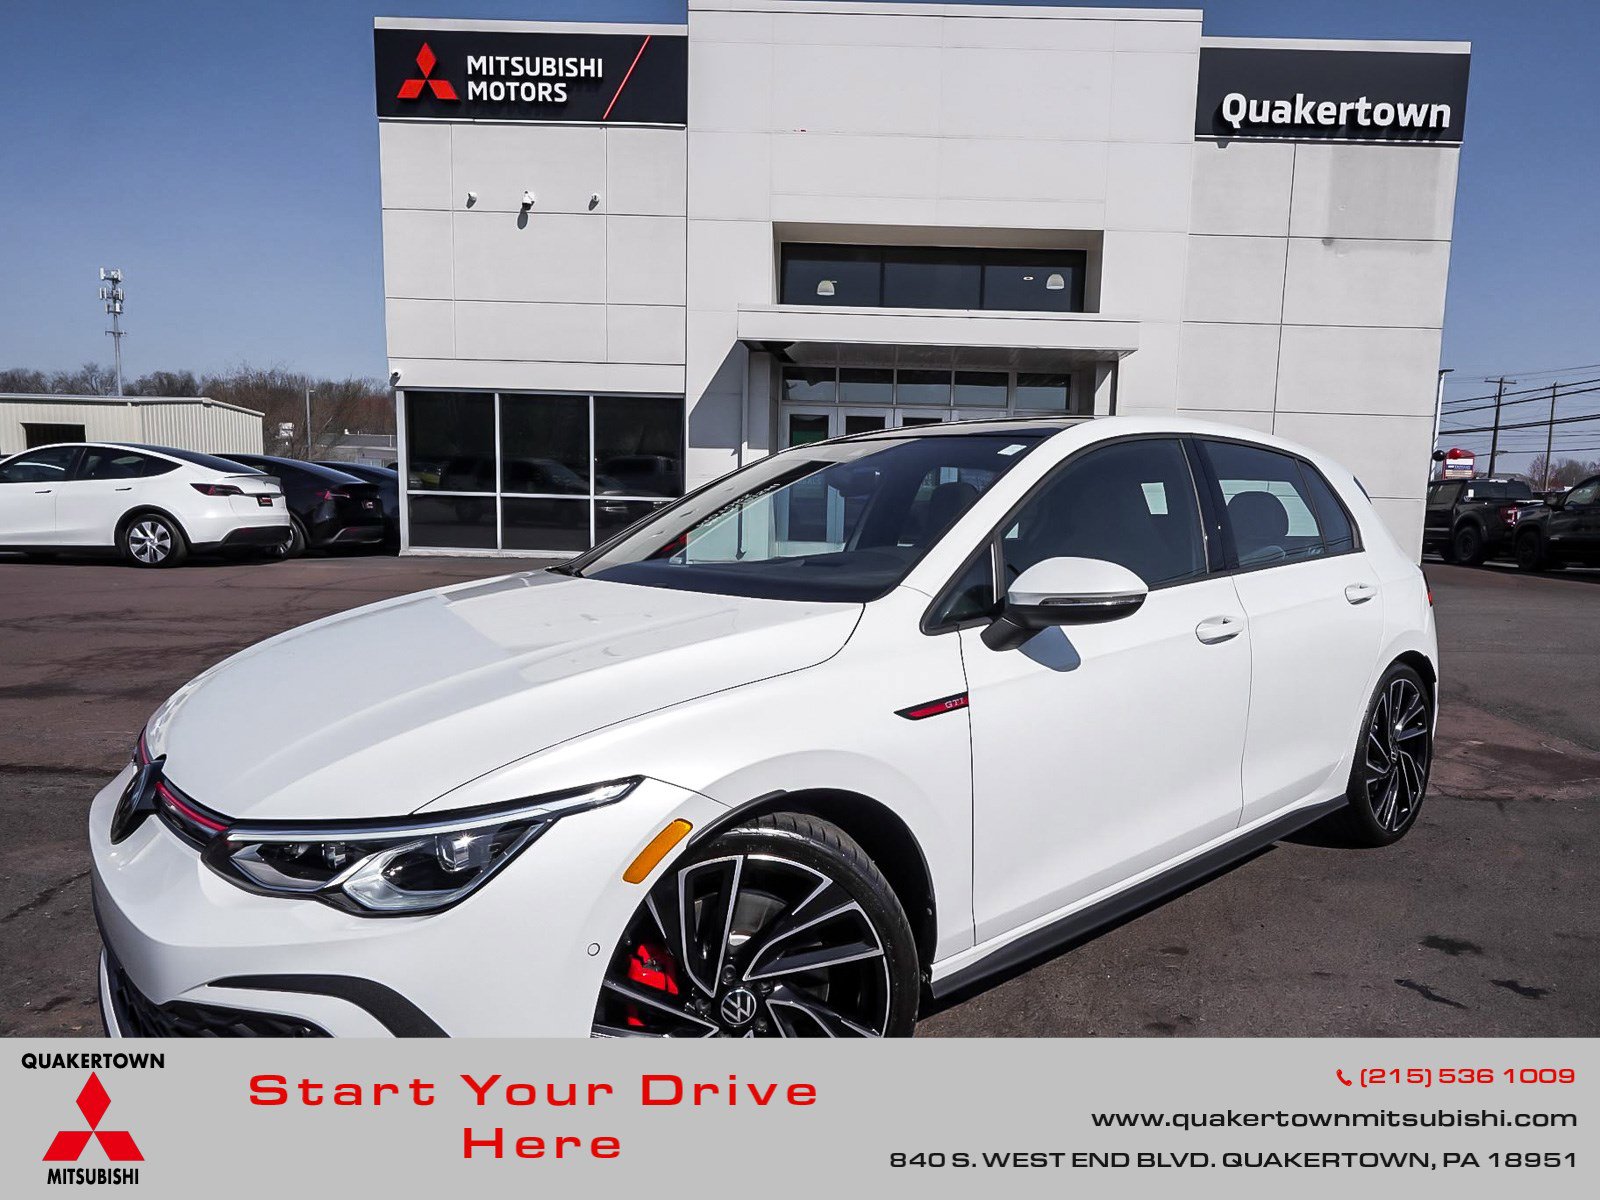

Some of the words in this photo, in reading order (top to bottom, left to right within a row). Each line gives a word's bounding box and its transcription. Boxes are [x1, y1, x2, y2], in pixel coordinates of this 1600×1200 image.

[467, 55, 603, 78] MITSUBISHI
[467, 80, 568, 103] MOTORS
[1222, 92, 1451, 128] Quakertown
[945, 698, 965, 709] GTI
